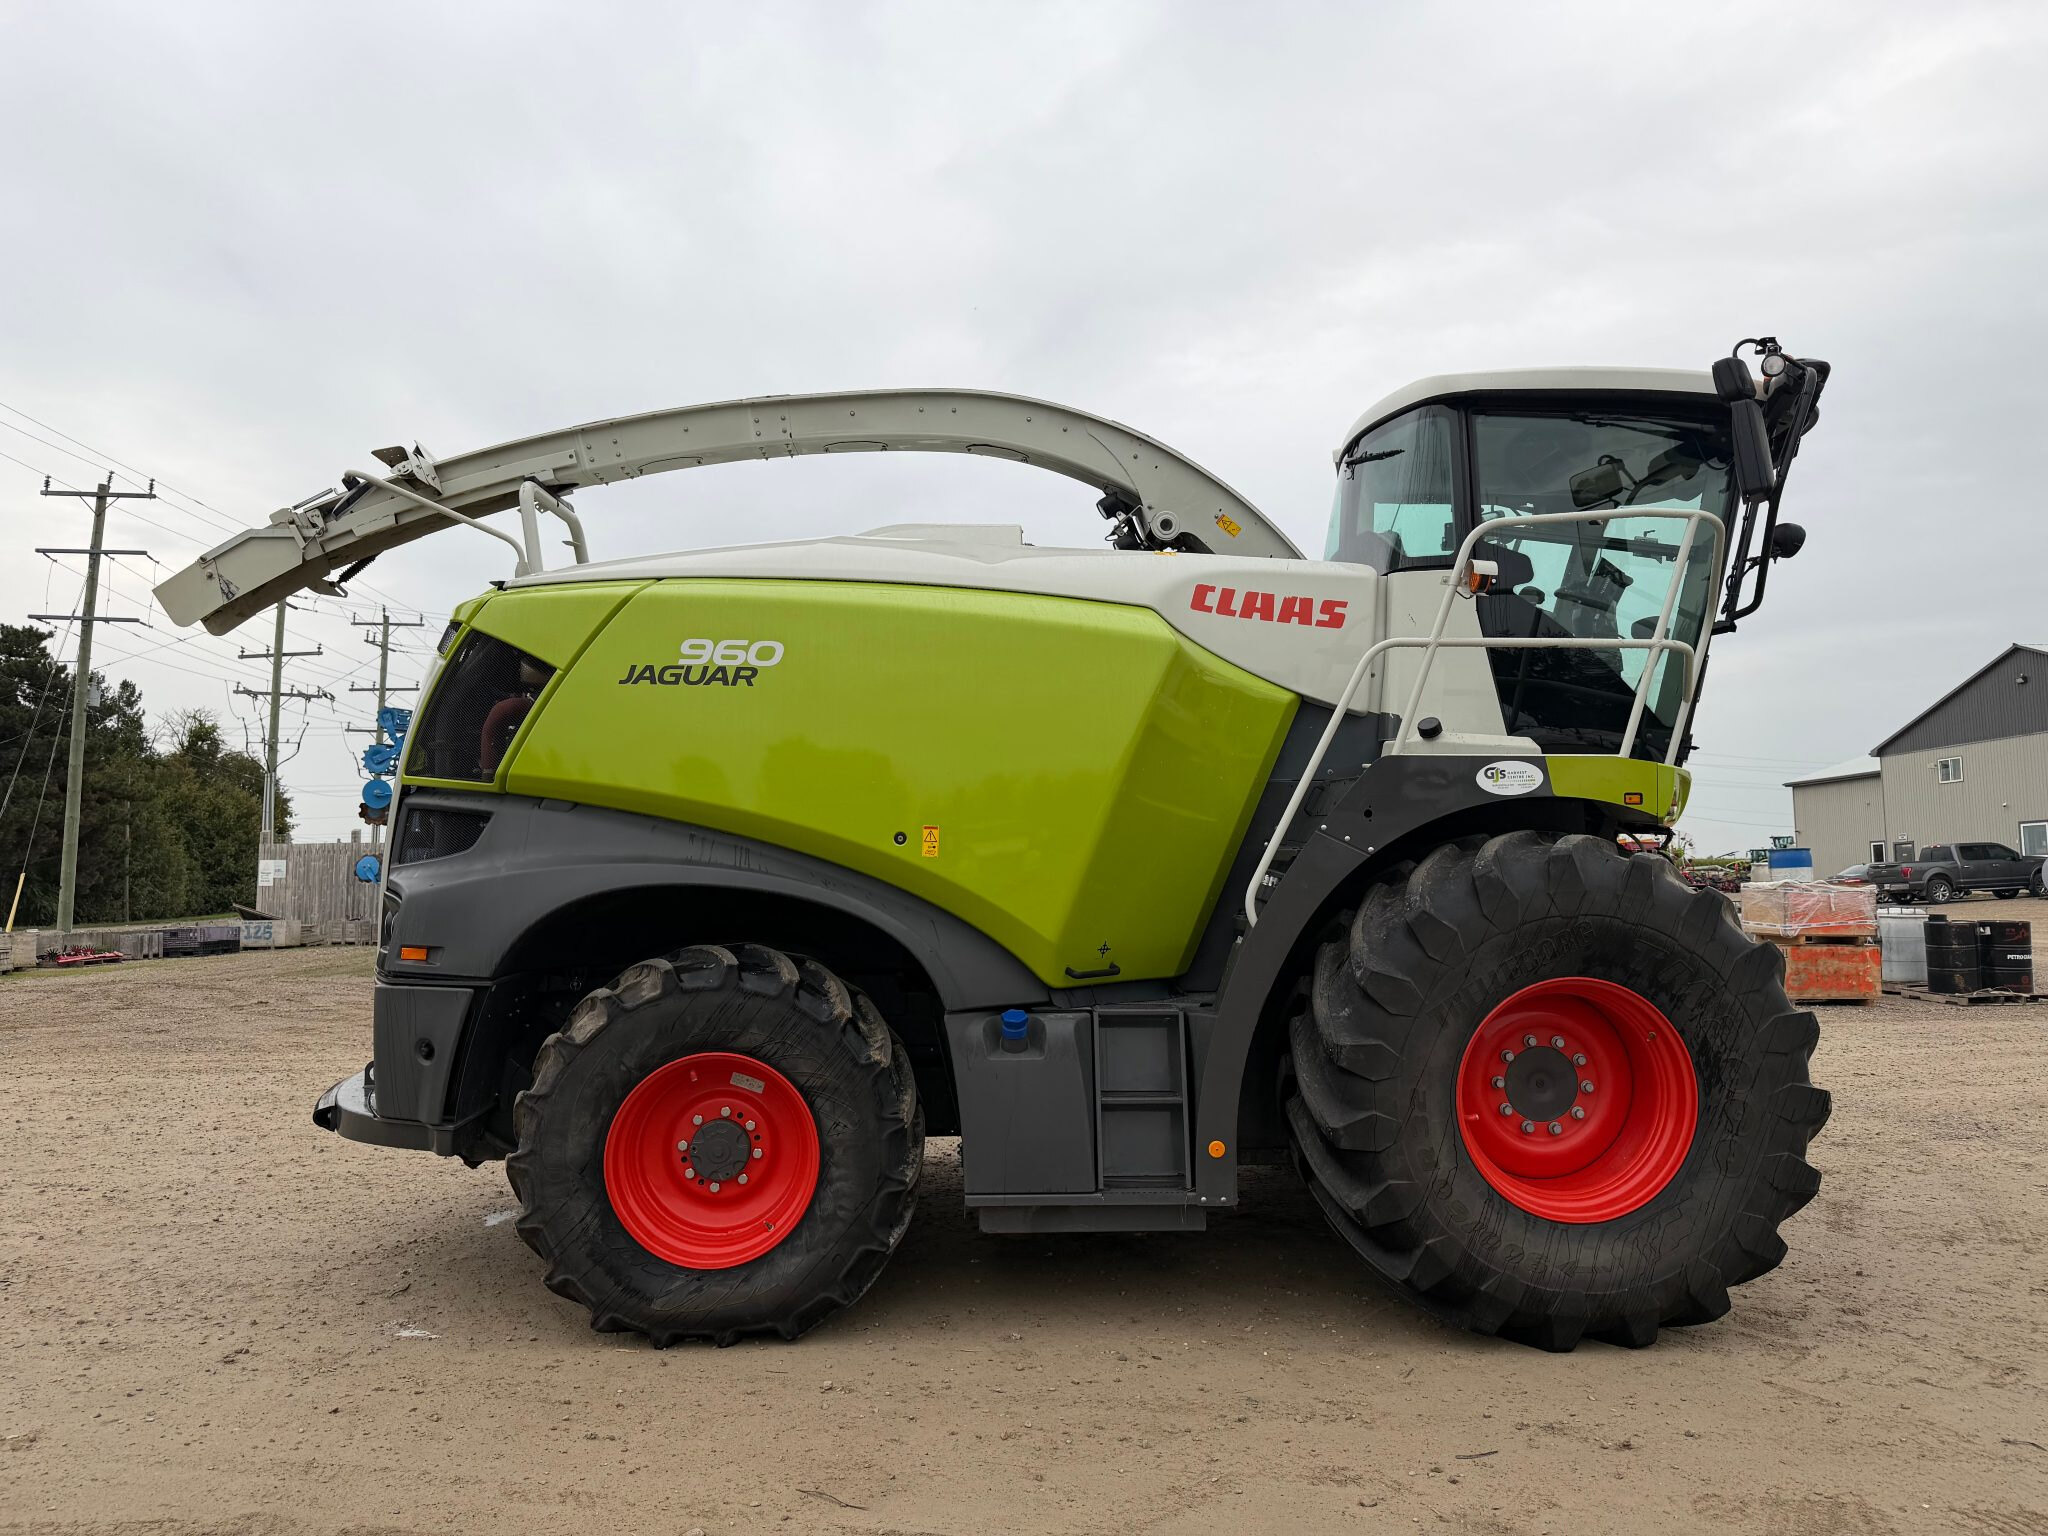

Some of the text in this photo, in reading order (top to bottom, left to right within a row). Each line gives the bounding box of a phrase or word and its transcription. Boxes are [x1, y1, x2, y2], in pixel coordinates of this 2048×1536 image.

[1190, 584, 1349, 629] CLAAS
[678, 638, 785, 667] 960
[618, 664, 758, 687] JAGUAR
